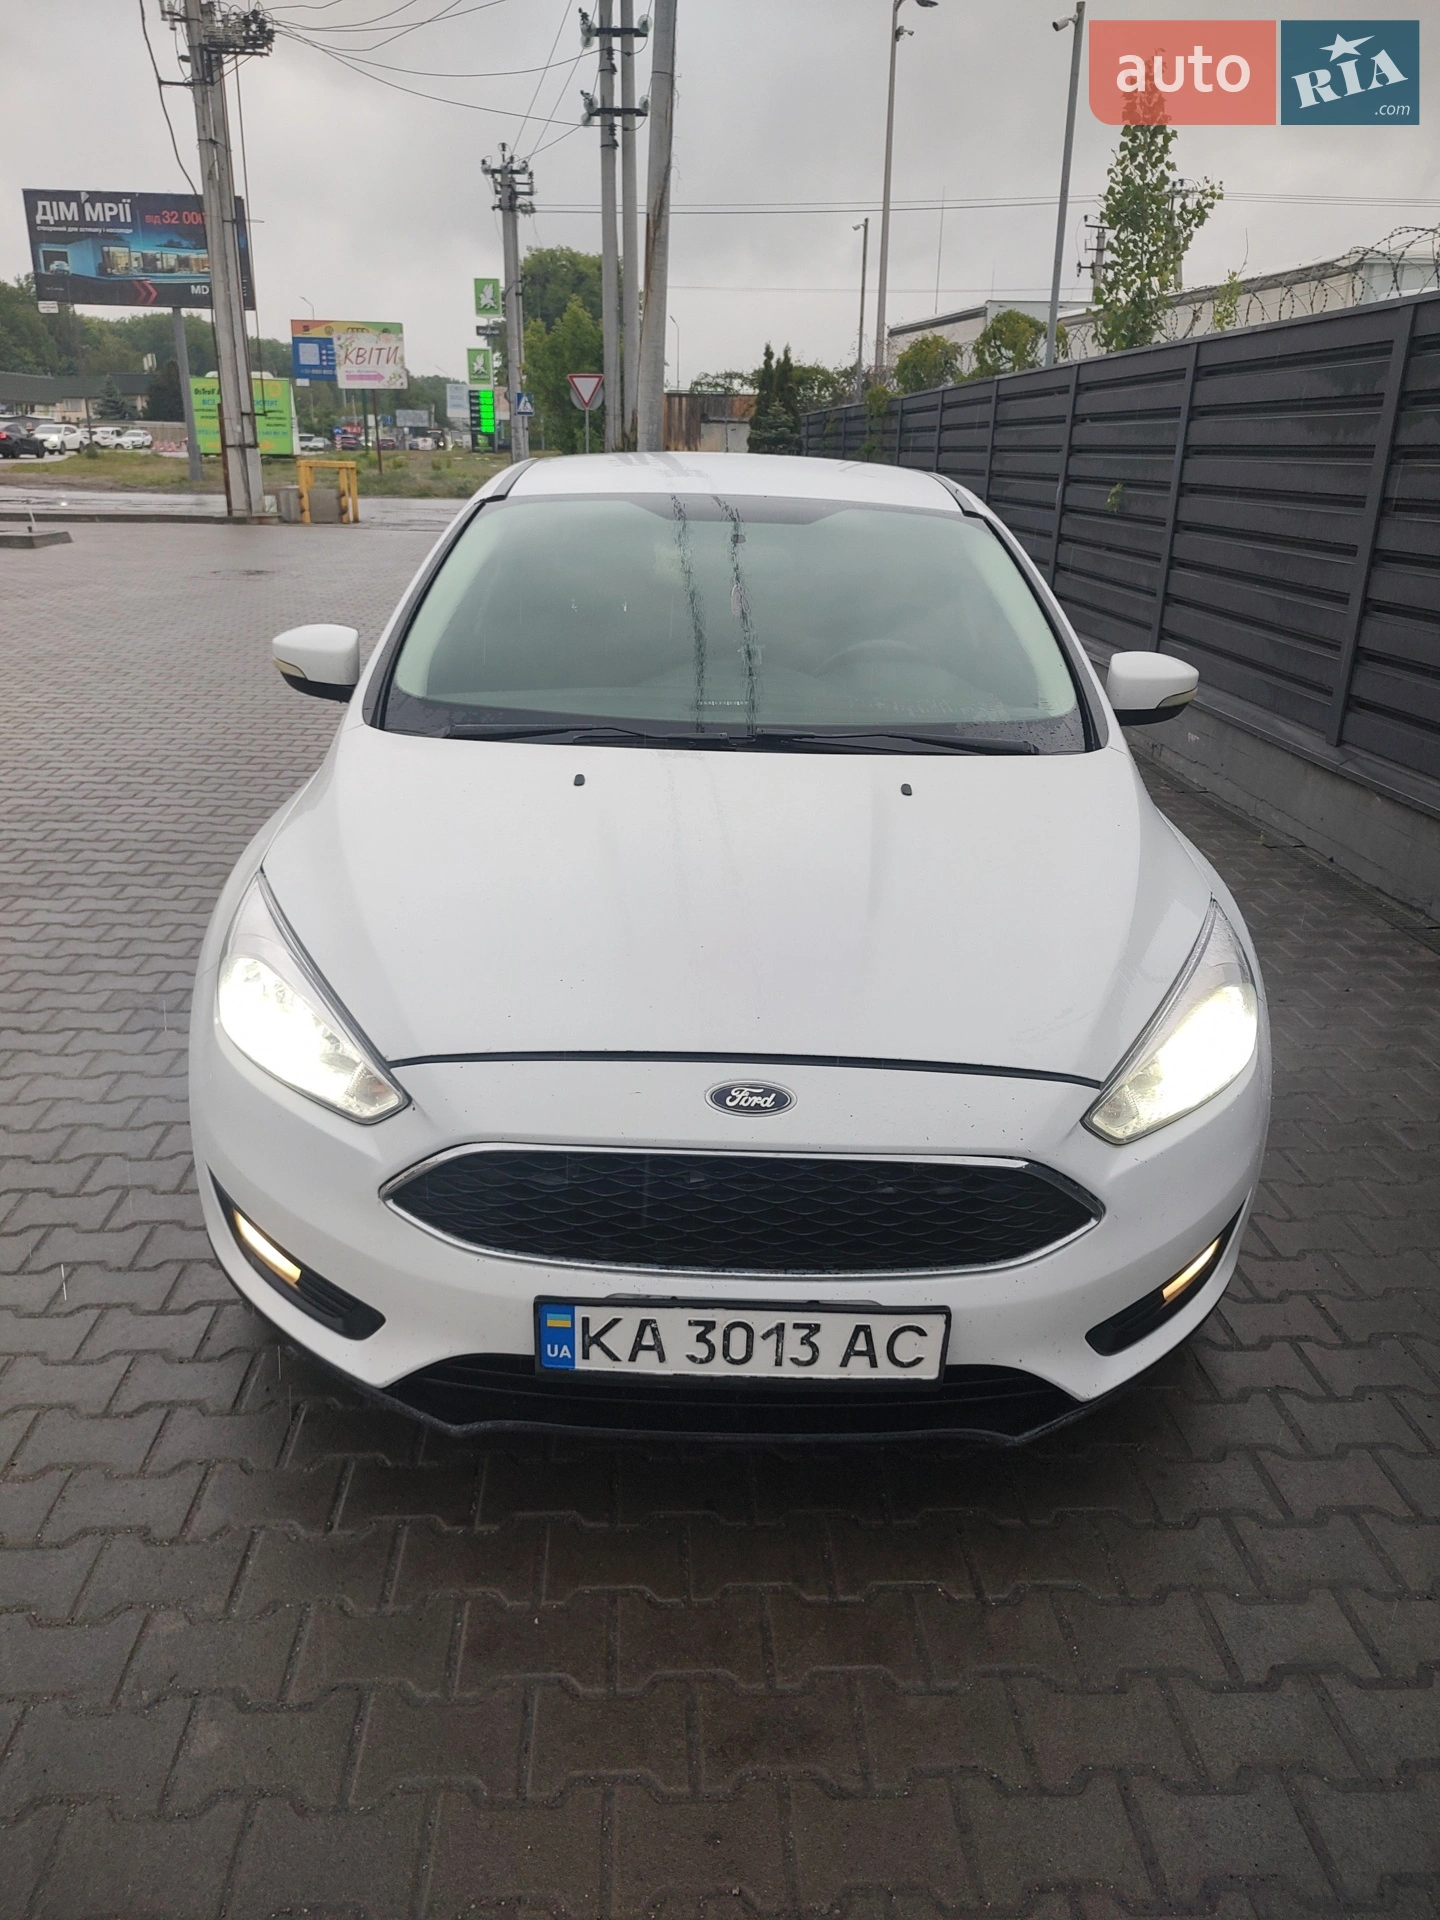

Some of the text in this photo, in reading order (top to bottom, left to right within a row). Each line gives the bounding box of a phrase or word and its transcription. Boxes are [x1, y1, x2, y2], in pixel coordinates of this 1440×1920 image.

[35, 198, 132, 225] ДІМ МРІЇ
[161, 210, 180, 224] 32
[343, 346, 400, 366] КВІТИ
[725, 1087, 777, 1108] Ford
[546, 1343, 572, 1359] UA
[581, 1316, 929, 1369] KA 3013 AC
